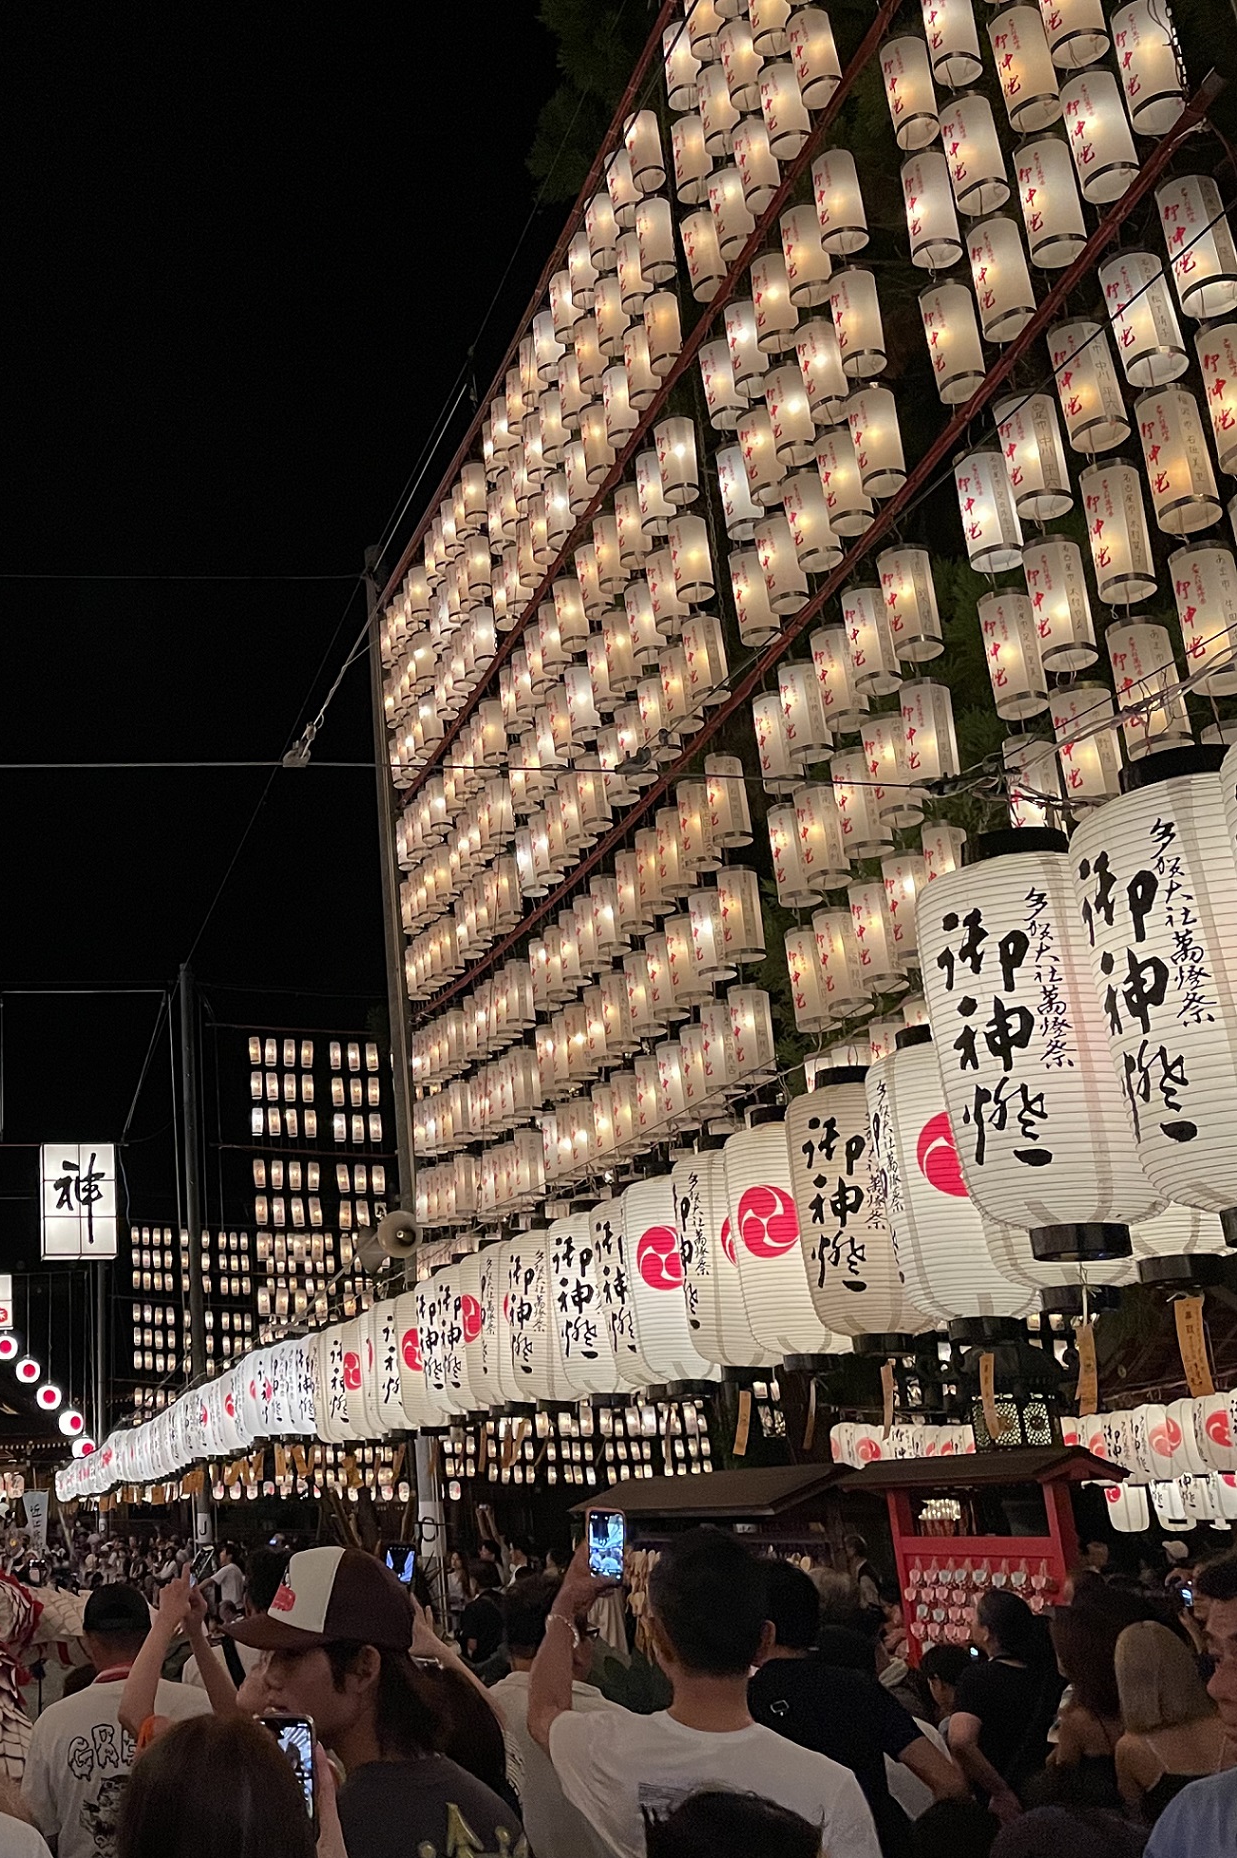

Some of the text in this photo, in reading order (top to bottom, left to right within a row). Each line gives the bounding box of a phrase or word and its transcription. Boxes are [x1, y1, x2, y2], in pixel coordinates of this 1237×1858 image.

[1023, 886, 1077, 1070] 多賀大社萬燈祭
[1149, 816, 1217, 1029] 多賀大社萬燈祭
[936, 907, 1054, 1167] 御神燈
[1078, 850, 1198, 1144] 御神燈
[53, 1152, 106, 1244] 神
[802, 1116, 867, 1293] 御神燈
[416, 1293, 445, 1390] 御神燈
[438, 1284, 463, 1389] 御神燈
[508, 1255, 535, 1374] 御神燈
[552, 1235, 599, 1359] 御神燈
[198, 1520, 208, 1536] J
